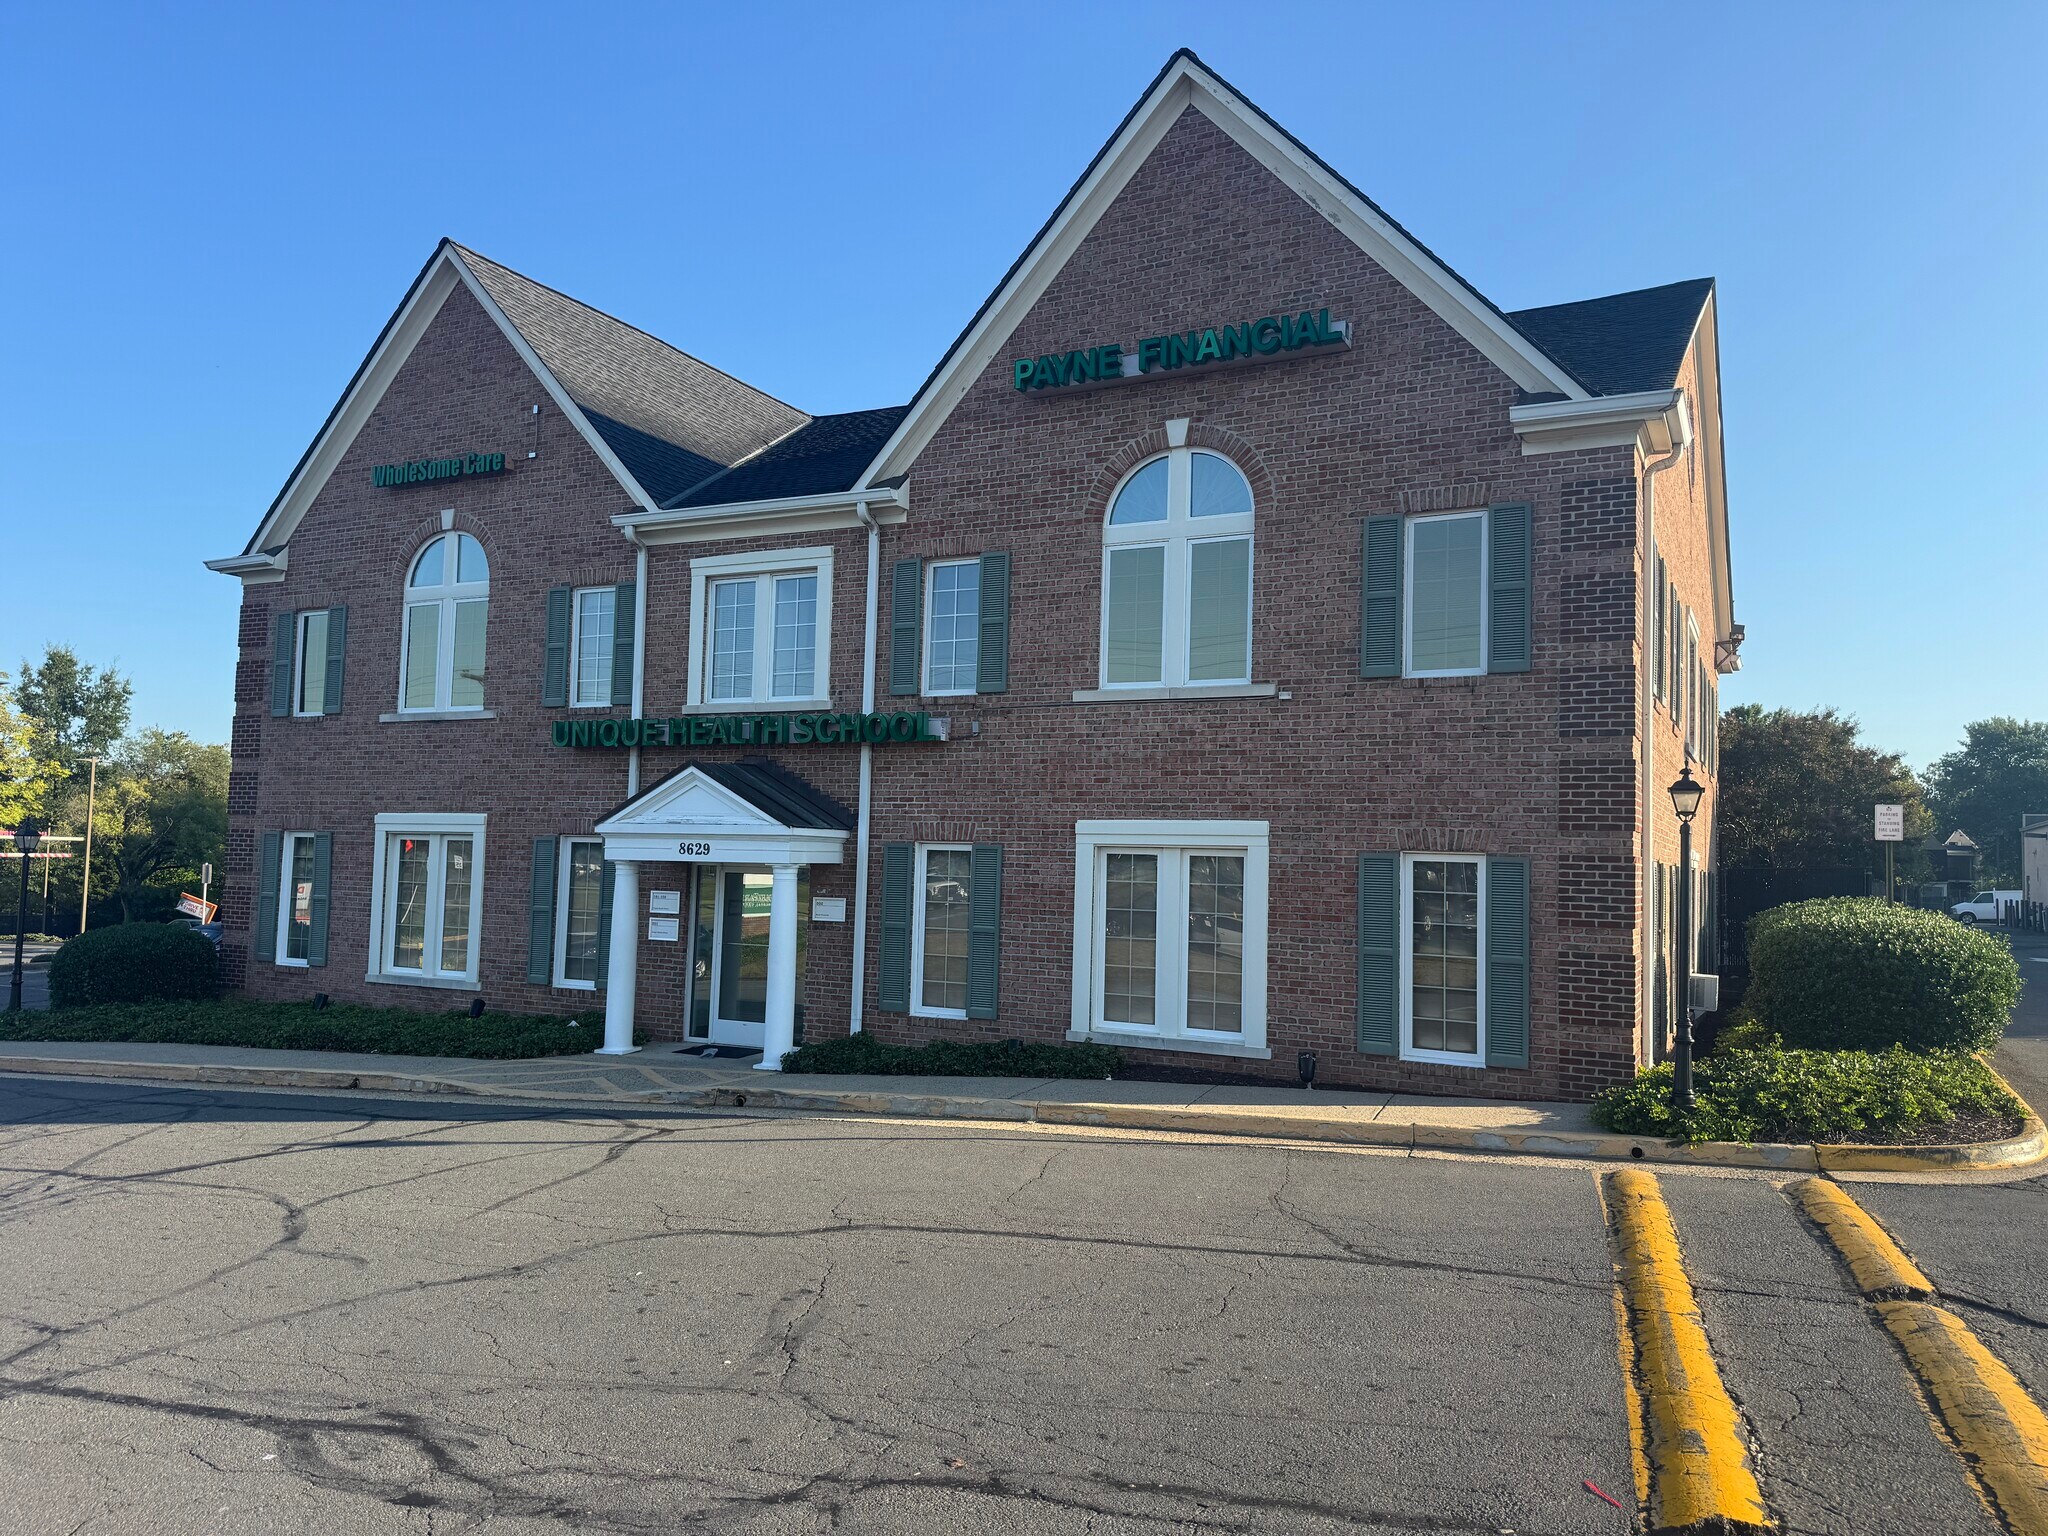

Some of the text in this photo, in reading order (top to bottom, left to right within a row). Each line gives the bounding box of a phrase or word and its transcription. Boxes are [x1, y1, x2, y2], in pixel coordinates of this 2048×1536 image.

[1013, 308, 1345, 393] PAYNE FINANCIAL
[371, 452, 505, 488] WholeSome Care
[551, 711, 936, 748] UNIQUE HEALTH SCHOOL
[678, 842, 710, 856] 8629
[185, 901, 199, 910] DRIVE
